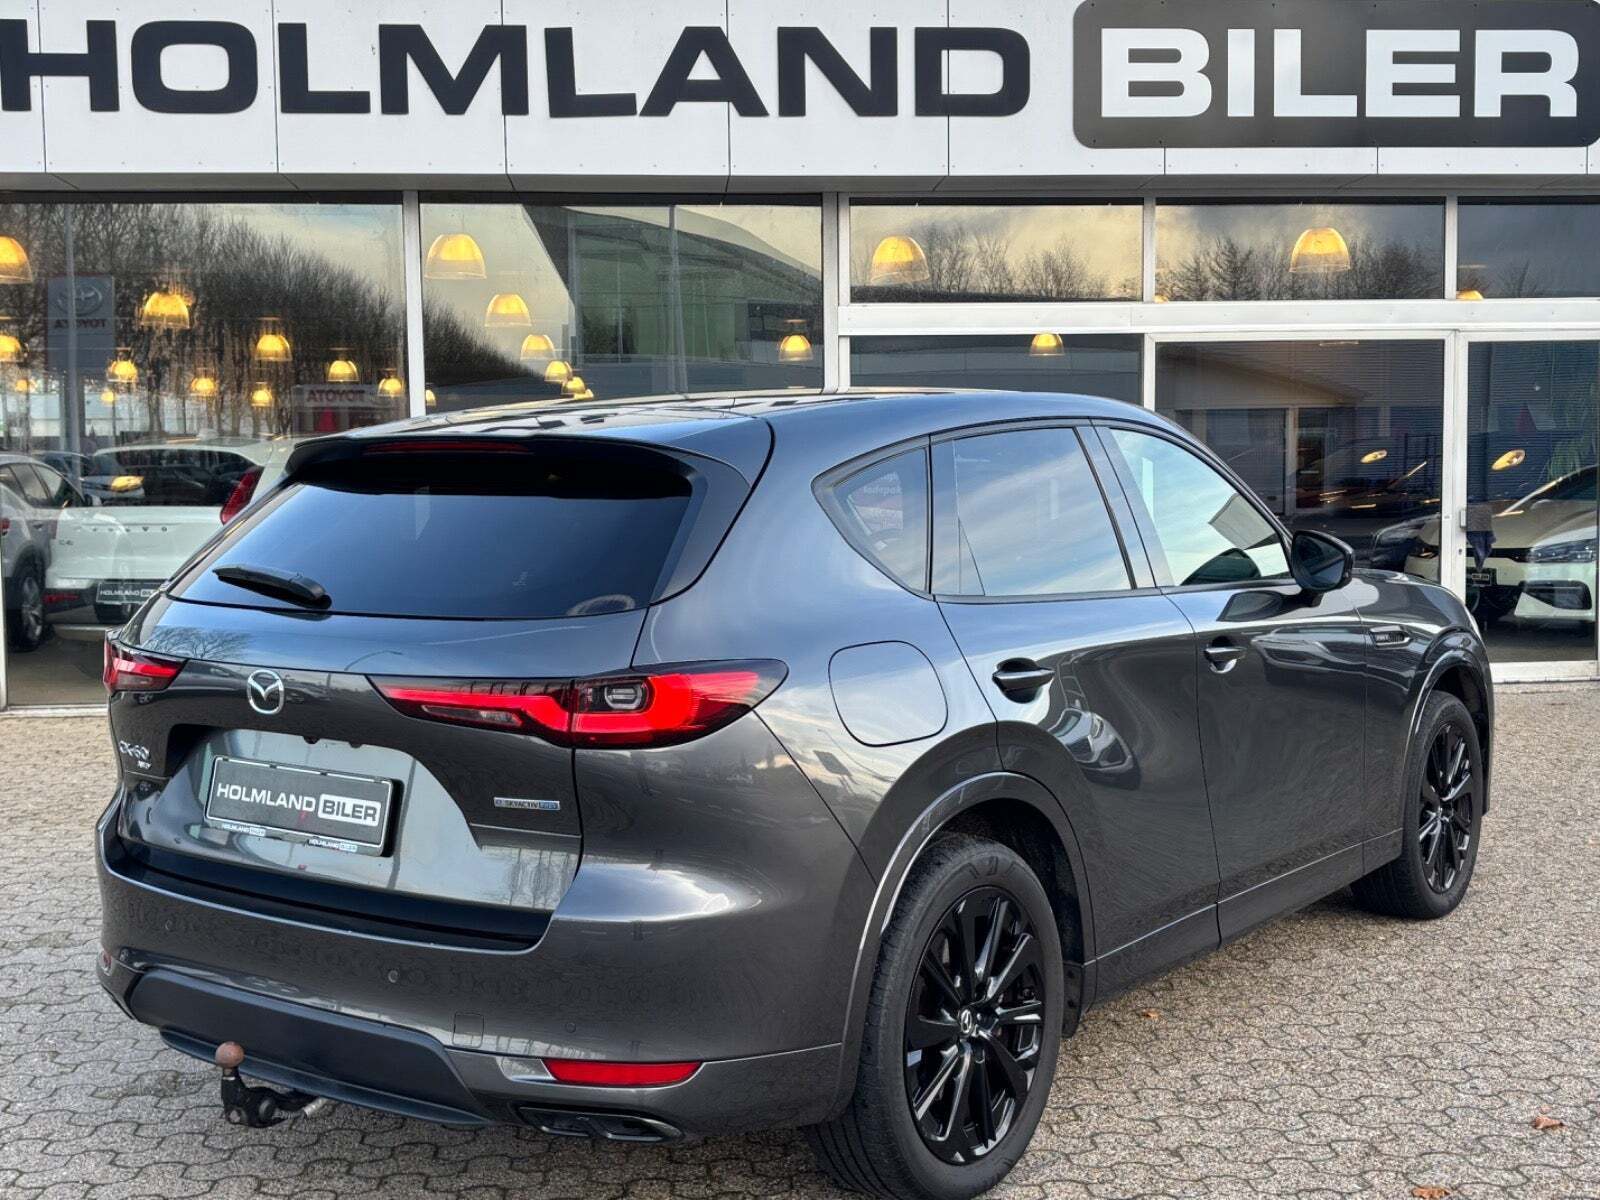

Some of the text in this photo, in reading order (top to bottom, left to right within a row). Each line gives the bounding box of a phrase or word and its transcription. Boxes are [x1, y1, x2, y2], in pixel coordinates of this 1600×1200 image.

[0, 18, 1580, 119] HOLMLAND BILER
[216, 782, 379, 822] HOLMLAND BILER
